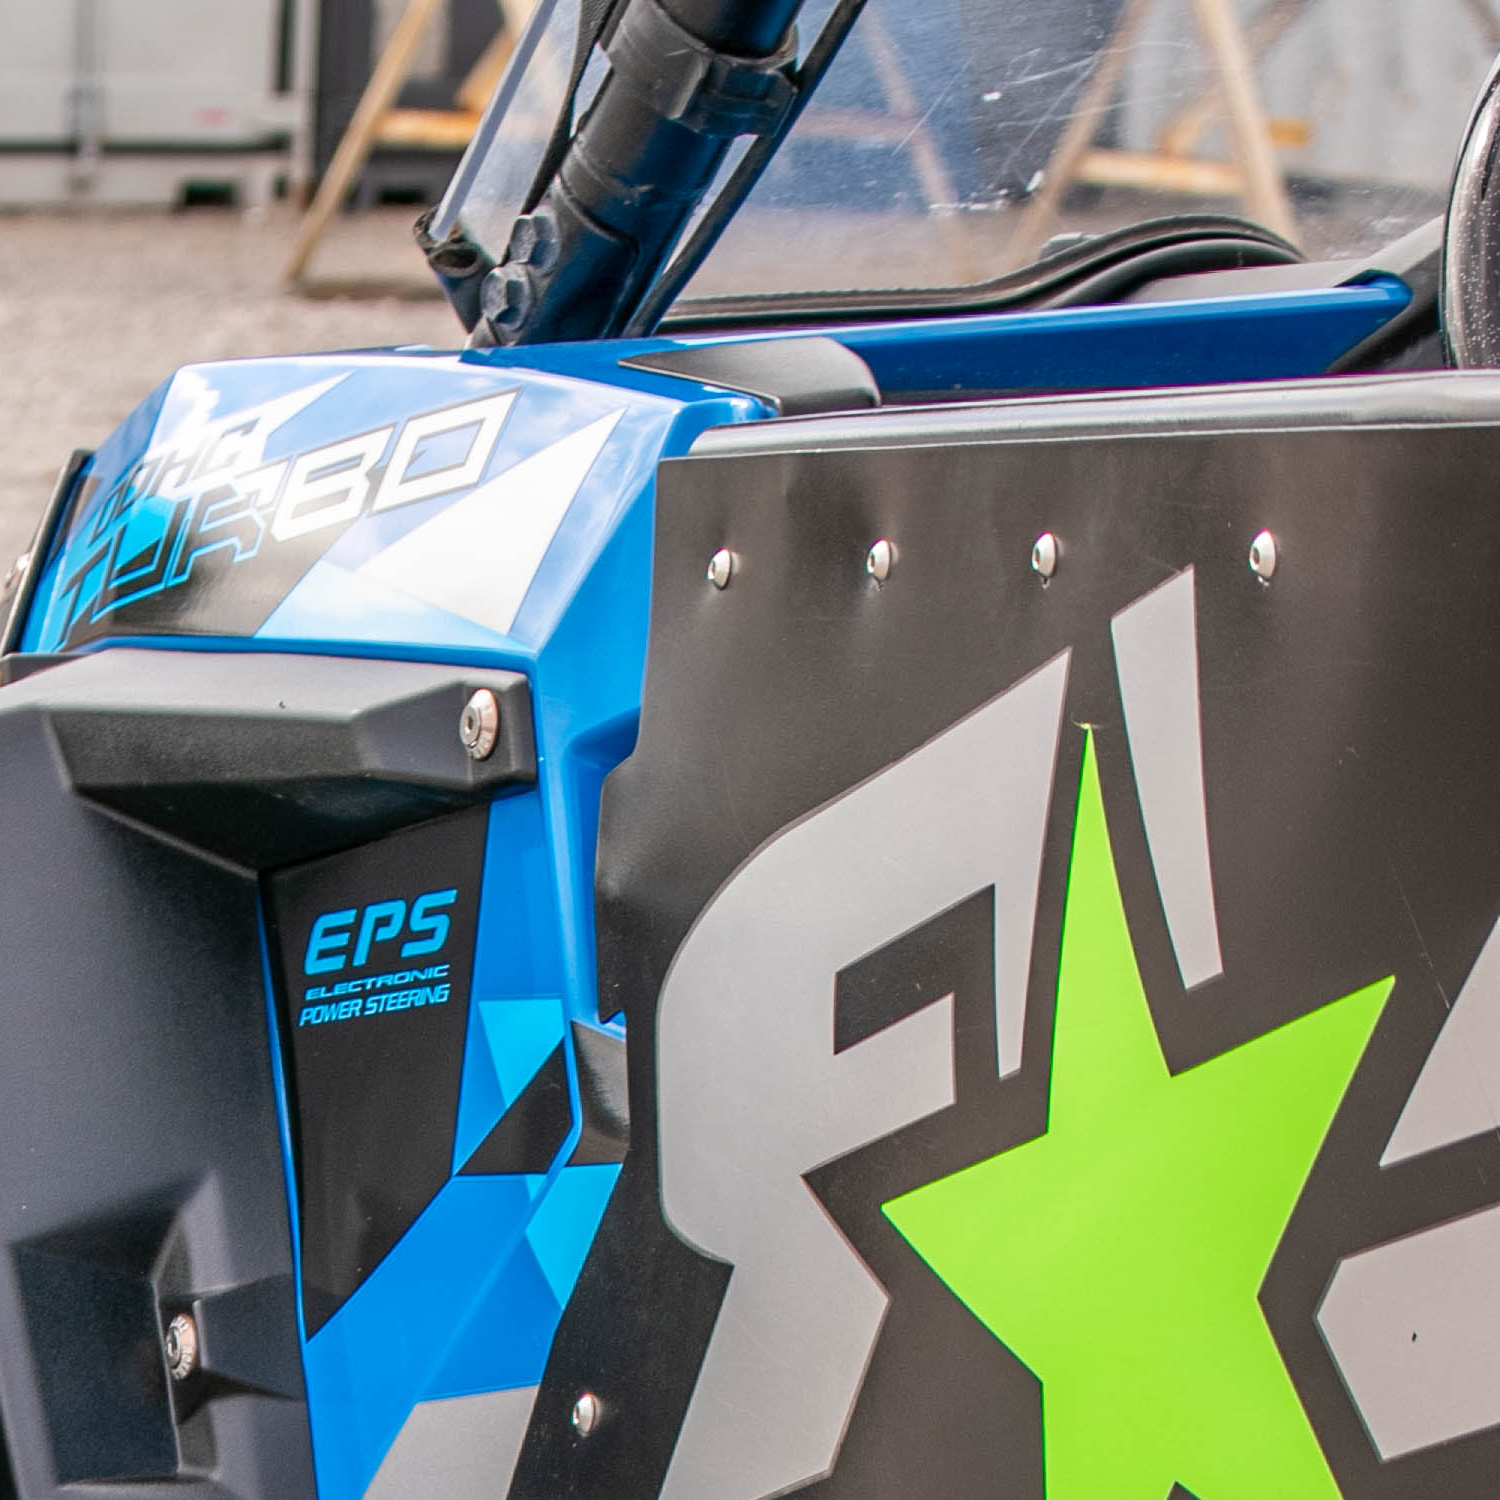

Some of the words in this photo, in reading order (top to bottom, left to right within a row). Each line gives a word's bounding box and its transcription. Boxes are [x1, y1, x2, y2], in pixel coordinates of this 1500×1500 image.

[52, 386, 524, 653] TURBO
[304, 888, 458, 976] EPS
[299, 998, 363, 1027] POWER
[363, 983, 451, 1016] STEERING
[304, 964, 451, 1001] ELECTRONIC
